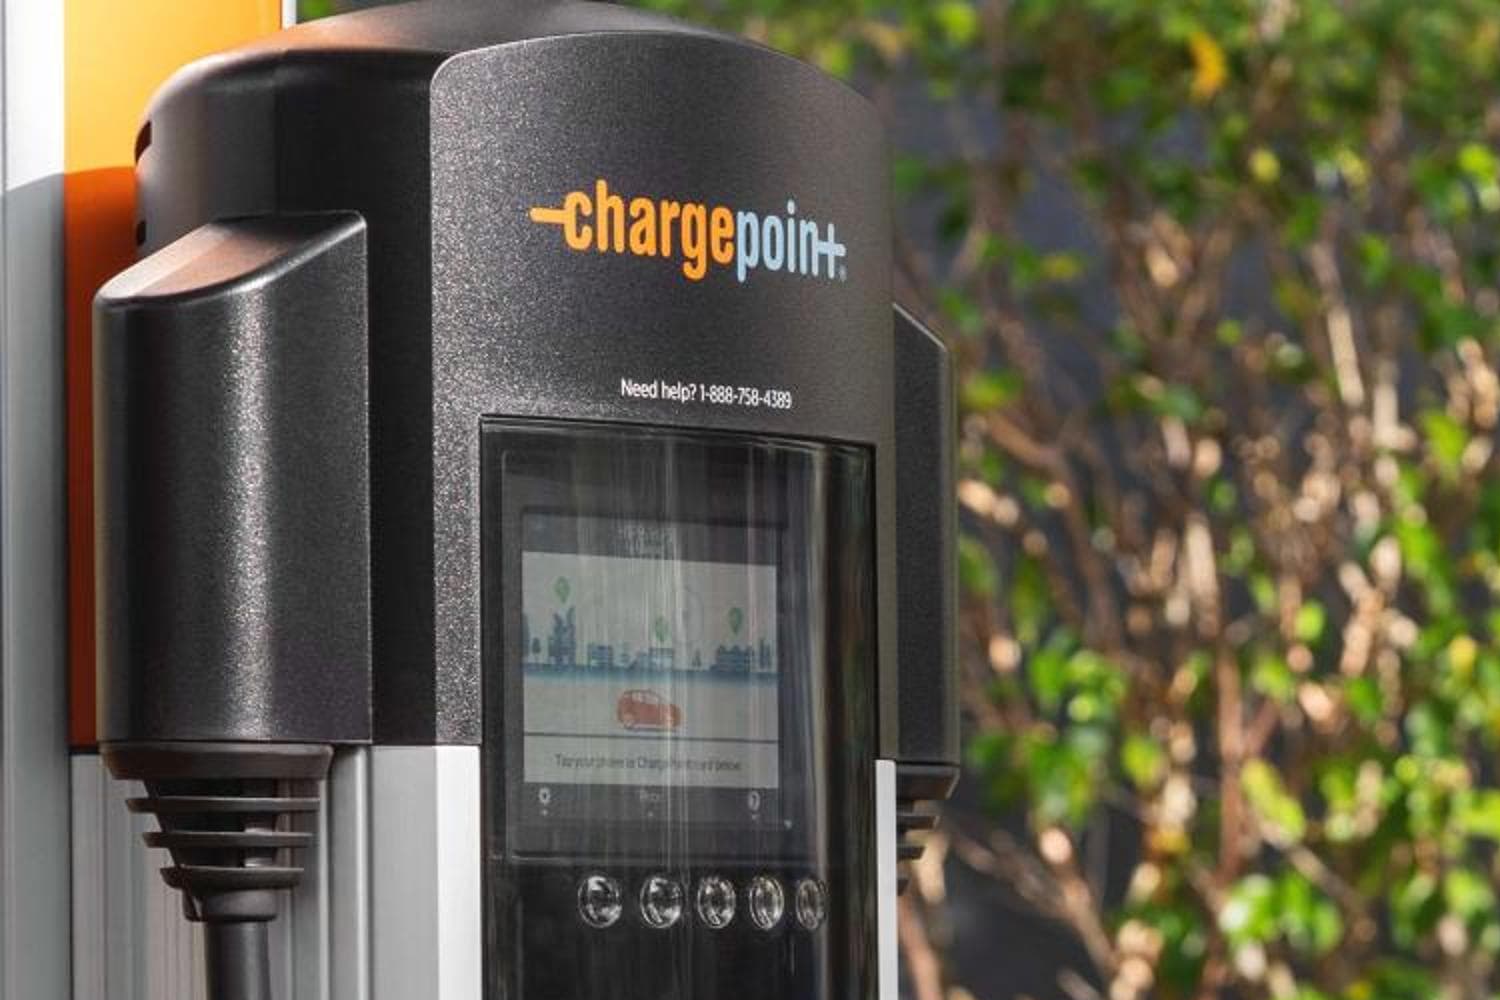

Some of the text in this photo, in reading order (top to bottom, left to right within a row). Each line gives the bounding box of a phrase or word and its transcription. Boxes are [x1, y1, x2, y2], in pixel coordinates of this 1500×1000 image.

[621, 377, 792, 409] Need help? 1-888-758-4389
